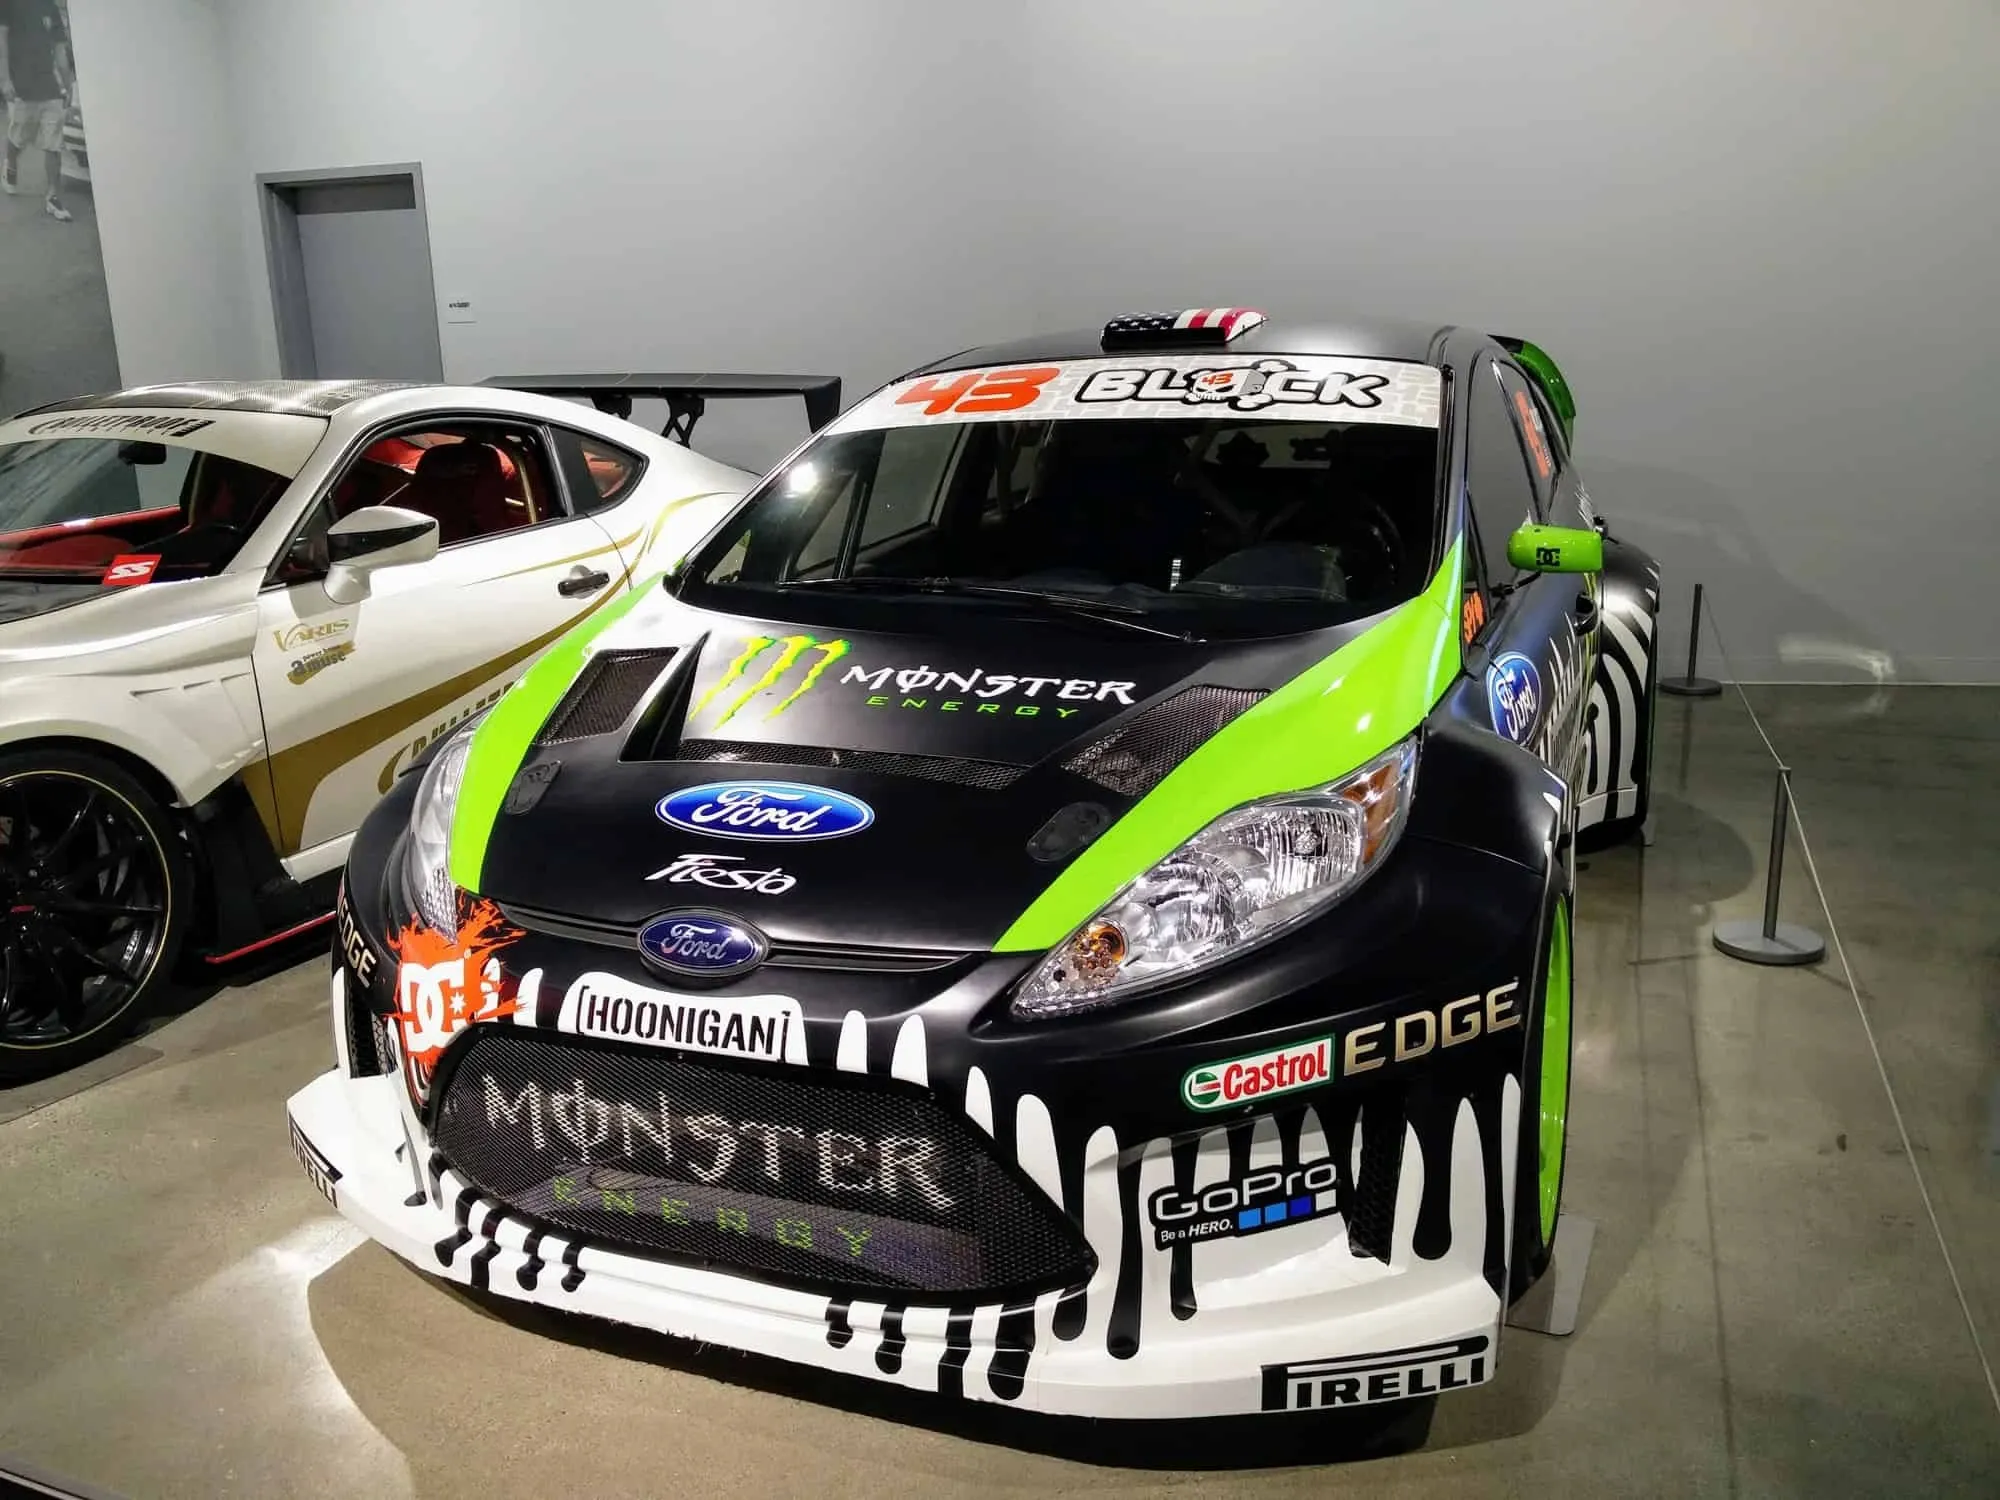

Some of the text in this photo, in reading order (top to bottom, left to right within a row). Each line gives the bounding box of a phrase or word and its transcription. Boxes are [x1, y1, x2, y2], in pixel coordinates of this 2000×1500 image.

[894, 367, 1061, 416] 43
[864, 695, 1080, 719] ENERGY
[1495, 668, 1538, 742] Ford
[691, 787, 833, 832] Ford
[644, 854, 798, 895] Fiesta
[662, 923, 733, 960] Ford
[1222, 980, 1522, 1101] Castrol EDGE
[552, 1174, 873, 1257] ENERGY
[1155, 1162, 1337, 1221] GoPro
[1161, 1229, 1176, 1242] Be
[1178, 1230, 1186, 1240] a
[1261, 1335, 1490, 1412] PIRELLI
